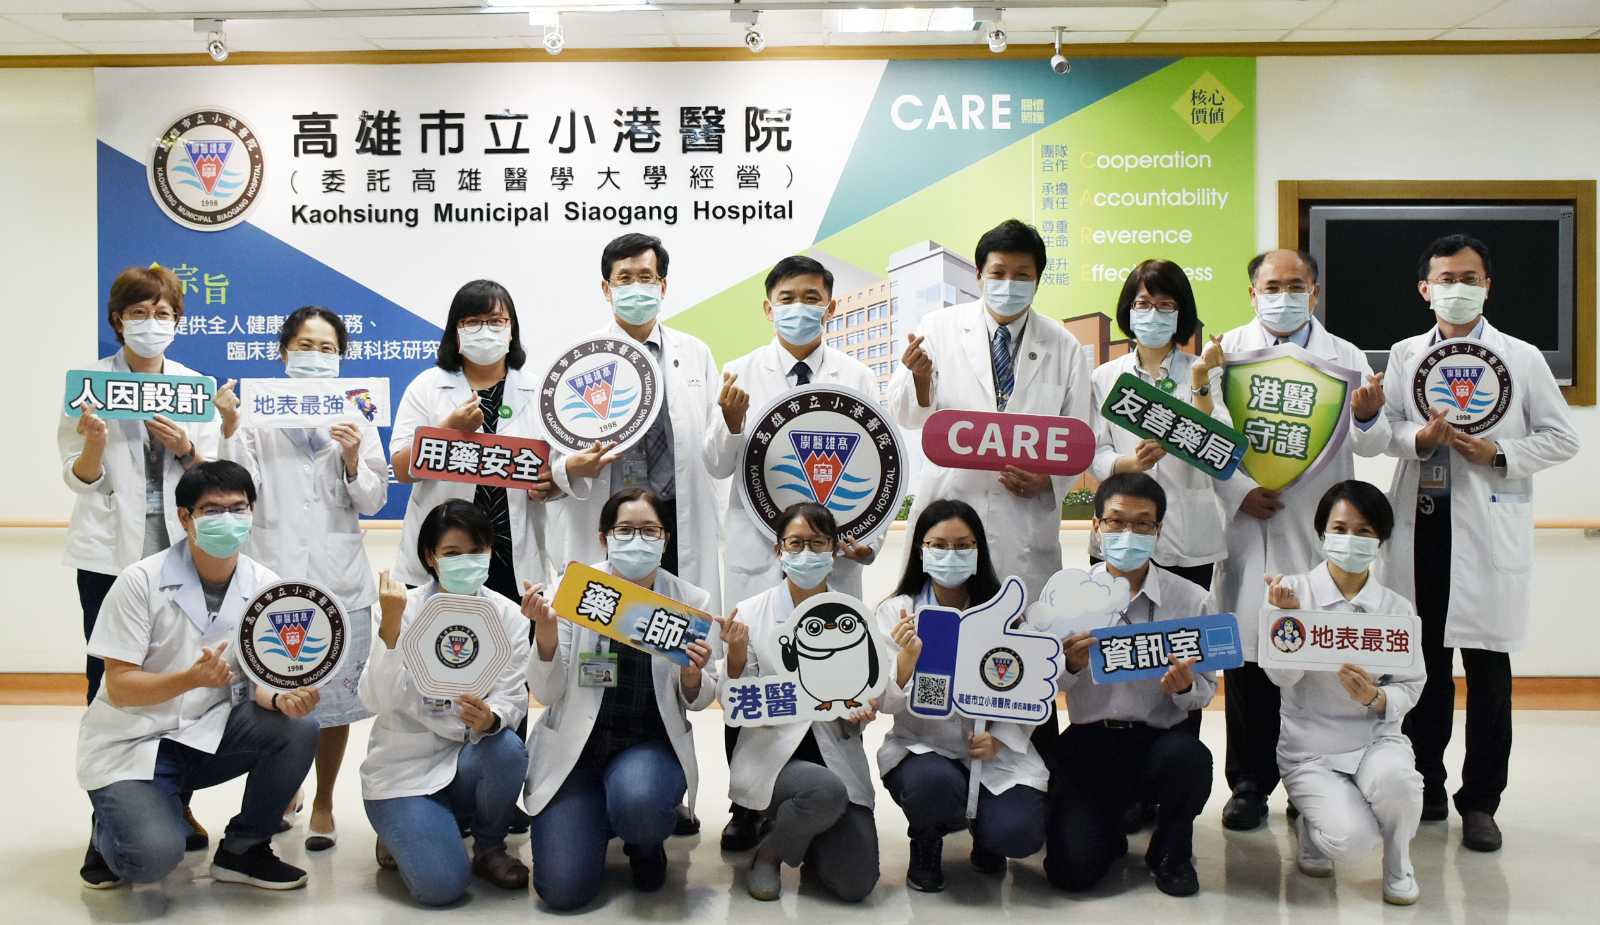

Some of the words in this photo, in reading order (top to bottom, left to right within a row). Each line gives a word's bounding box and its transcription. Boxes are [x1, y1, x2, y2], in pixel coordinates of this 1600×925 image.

[890, 93, 1012, 131] CARE
[1191, 88, 1225, 106] 核心
[1191, 107, 1225, 125] 價值
[292, 105, 793, 158] 高雄市立小港醫院
[1079, 151, 1212, 172] Cooperation
[291, 203, 419, 228] Kaohsiung
[434, 202, 549, 226] Municipal
[564, 201, 678, 225] Siaogang
[693, 200, 793, 224] Hospital
[1079, 188, 1229, 209] Accountability
[1081, 227, 1193, 244] Reverence
[171, 263, 230, 305] 宗旨
[1081, 264, 1213, 281] Effecess
[70, 378, 210, 415] 人因設計
[253, 393, 345, 416] 地表最強
[546, 412, 575, 444] KAOHSIUNG
[619, 408, 648, 440] SIAOGANG
[643, 370, 653, 406] HOSPITAL
[1249, 376, 1315, 416] 港醫
[756, 395, 892, 450] 高雄市立小港醫院
[947, 419, 1070, 463] CARE
[1110, 387, 1236, 470] 友善藥局
[1245, 419, 1309, 458] 守護
[415, 437, 544, 481] 用藥安全
[750, 464, 776, 520] KAOHSIUNG
[837, 514, 877, 542] IAOGANG
[876, 467, 896, 513] HOSPITAL
[265, 673, 299, 686] MUNICIPAL
[331, 628, 342, 660] HOSPITAL
[1102, 630, 1202, 673] 資訊室
[1310, 624, 1409, 653] 地表最強
[728, 682, 798, 720] 港醫
